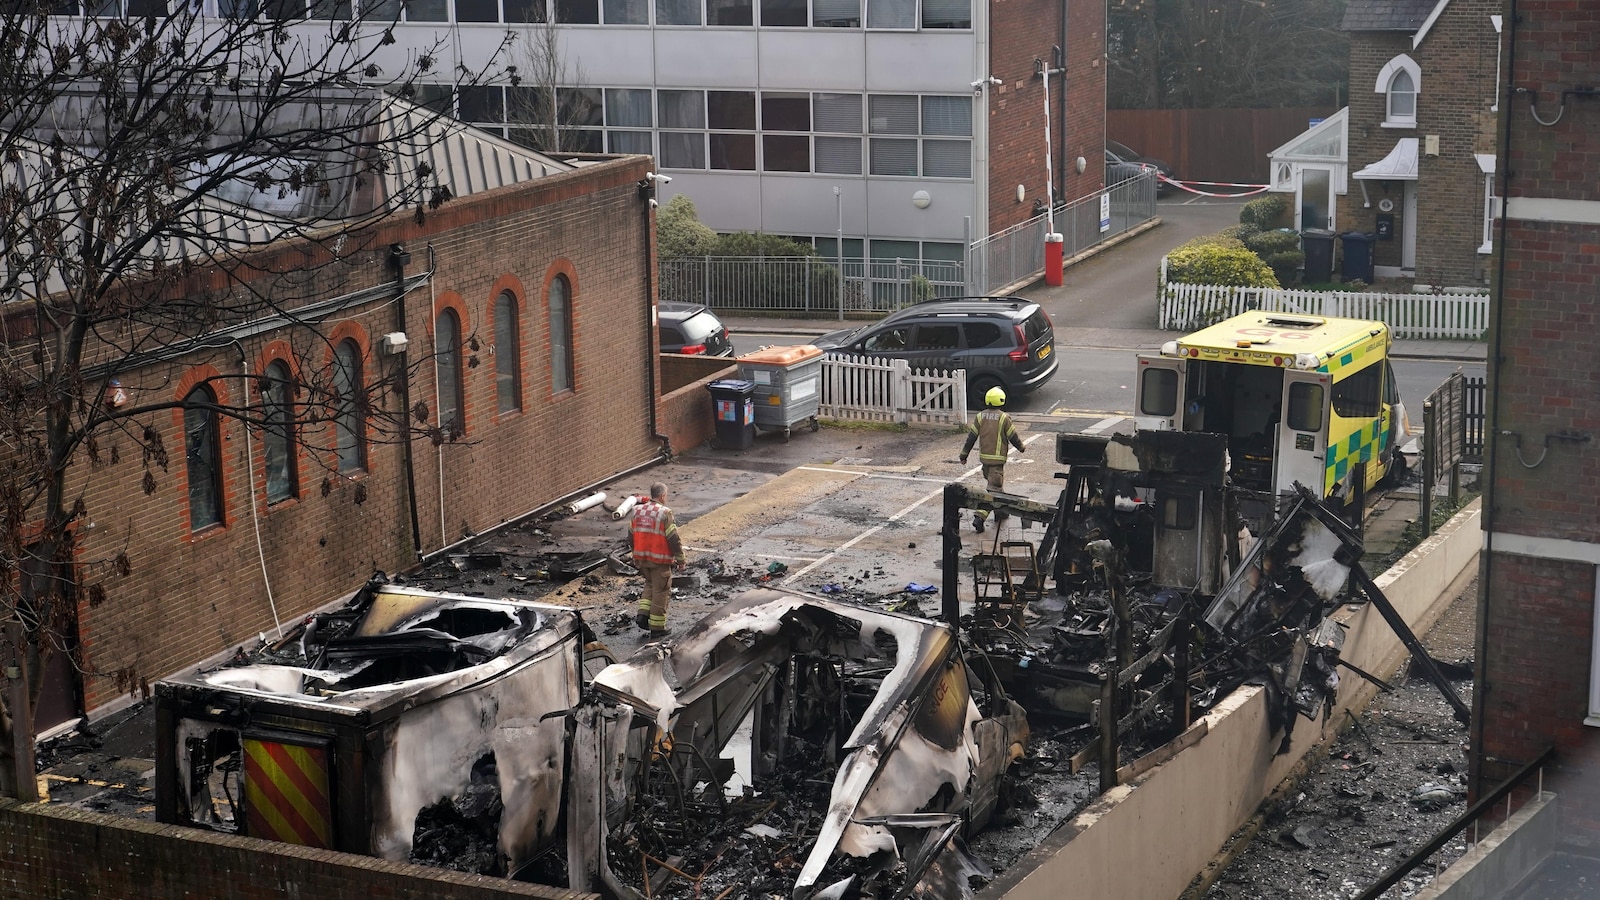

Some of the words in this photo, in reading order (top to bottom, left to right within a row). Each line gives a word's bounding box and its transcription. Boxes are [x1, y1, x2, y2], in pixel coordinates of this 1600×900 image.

[1236, 328, 1313, 340] G6
[1365, 339, 1385, 352] AMBULANCE
[981, 412, 1000, 420] FIRE
